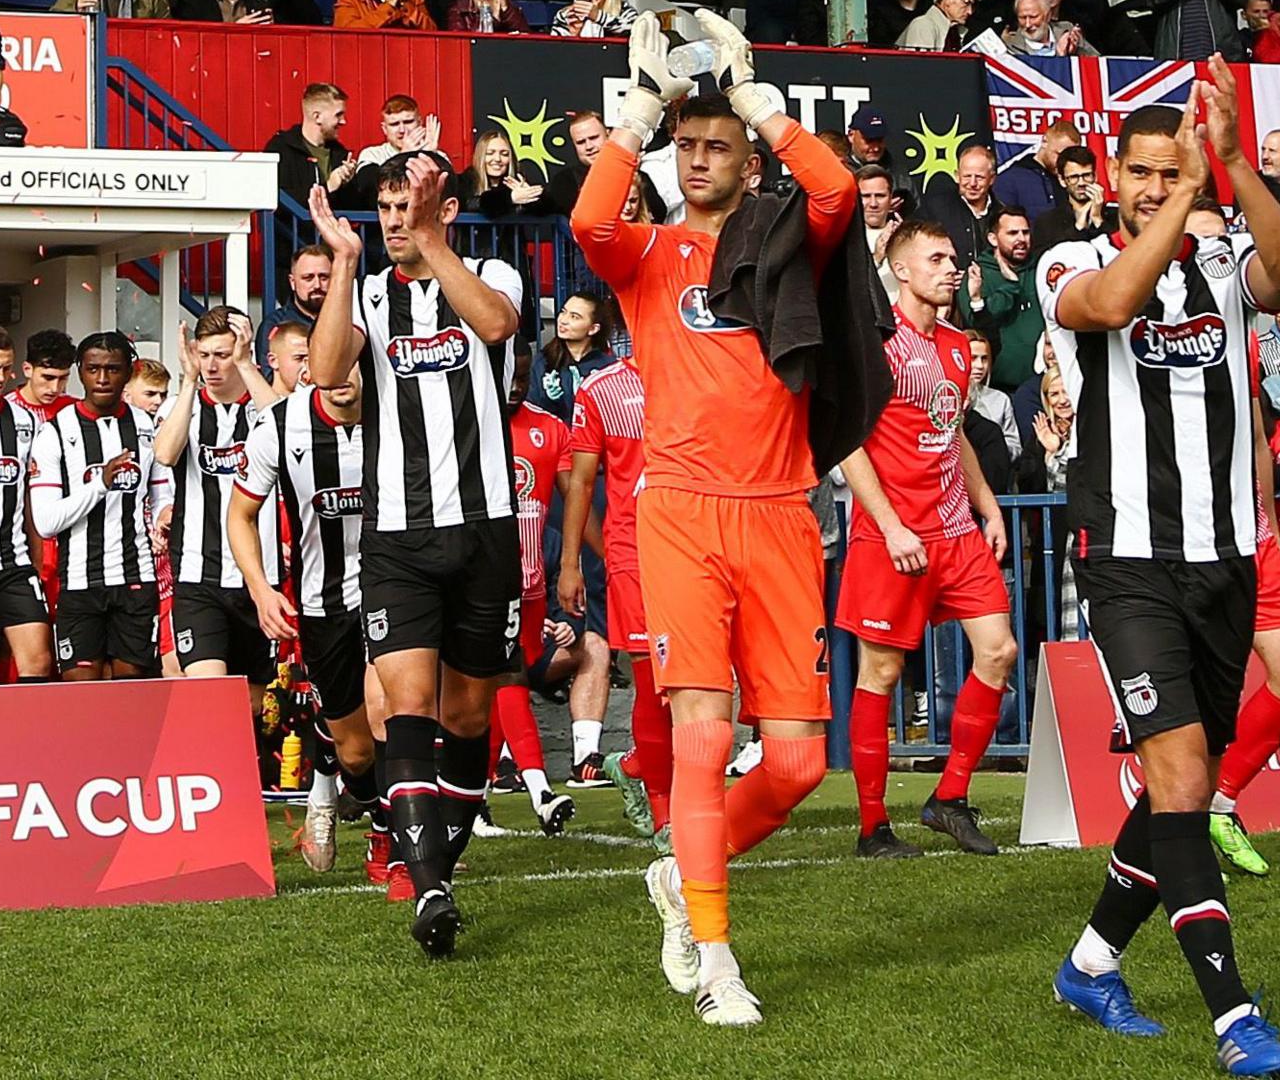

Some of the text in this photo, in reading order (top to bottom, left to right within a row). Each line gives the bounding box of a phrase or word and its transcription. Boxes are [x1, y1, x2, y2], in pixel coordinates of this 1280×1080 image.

[1073, 110, 1111, 135] ON
[20, 169, 127, 192] OFFICIALS
[135, 172, 190, 194] ONLY
[394, 336, 466, 373] Young's
[1144, 322, 1225, 361] Young's
[504, 598, 521, 639] 5
[76, 774, 222, 838] CUP
